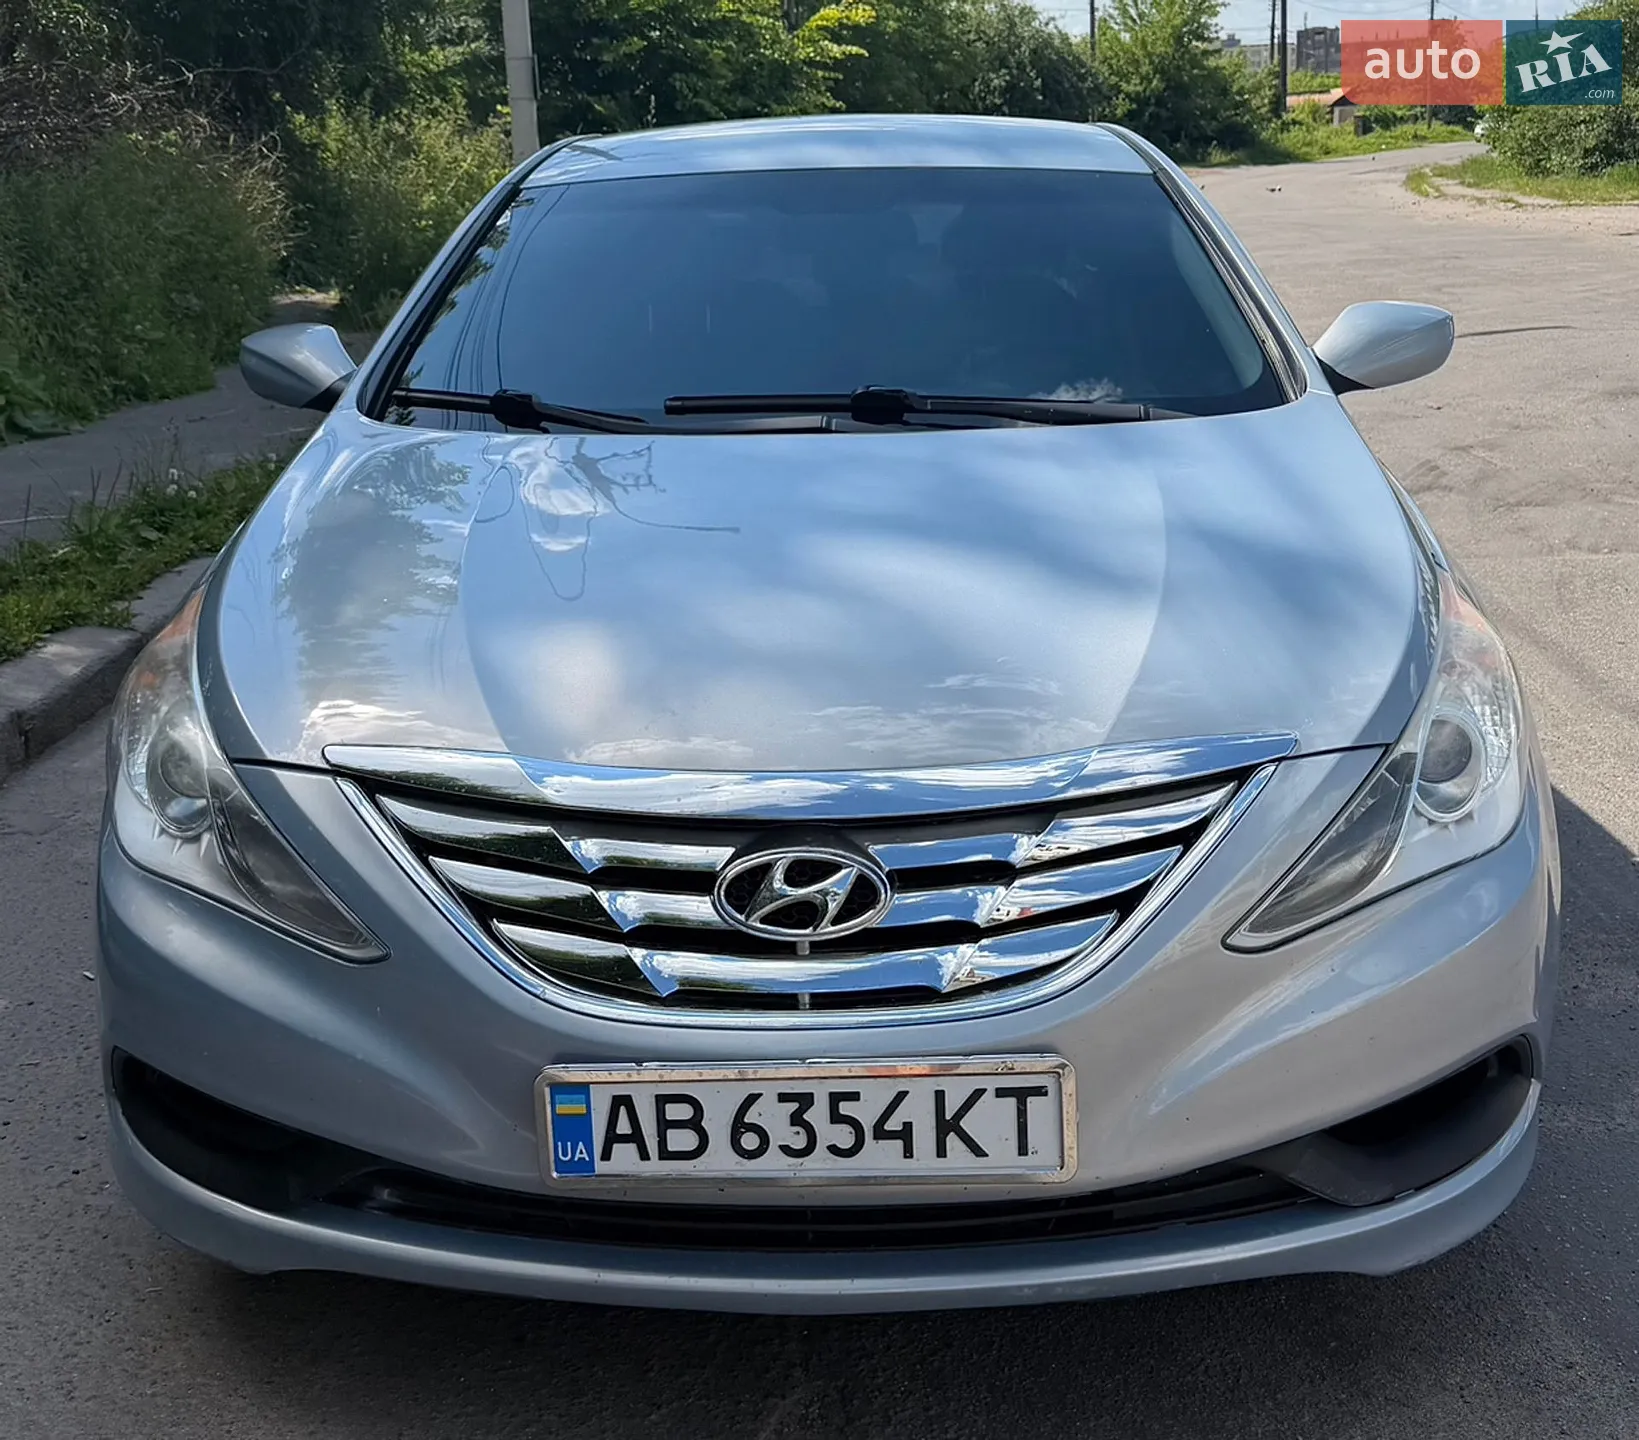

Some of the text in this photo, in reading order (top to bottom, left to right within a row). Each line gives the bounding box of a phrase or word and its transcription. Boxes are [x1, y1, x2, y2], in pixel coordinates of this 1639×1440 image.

[600, 1085, 1049, 1161] AB 6354 KT
[557, 1141, 590, 1162] UA
